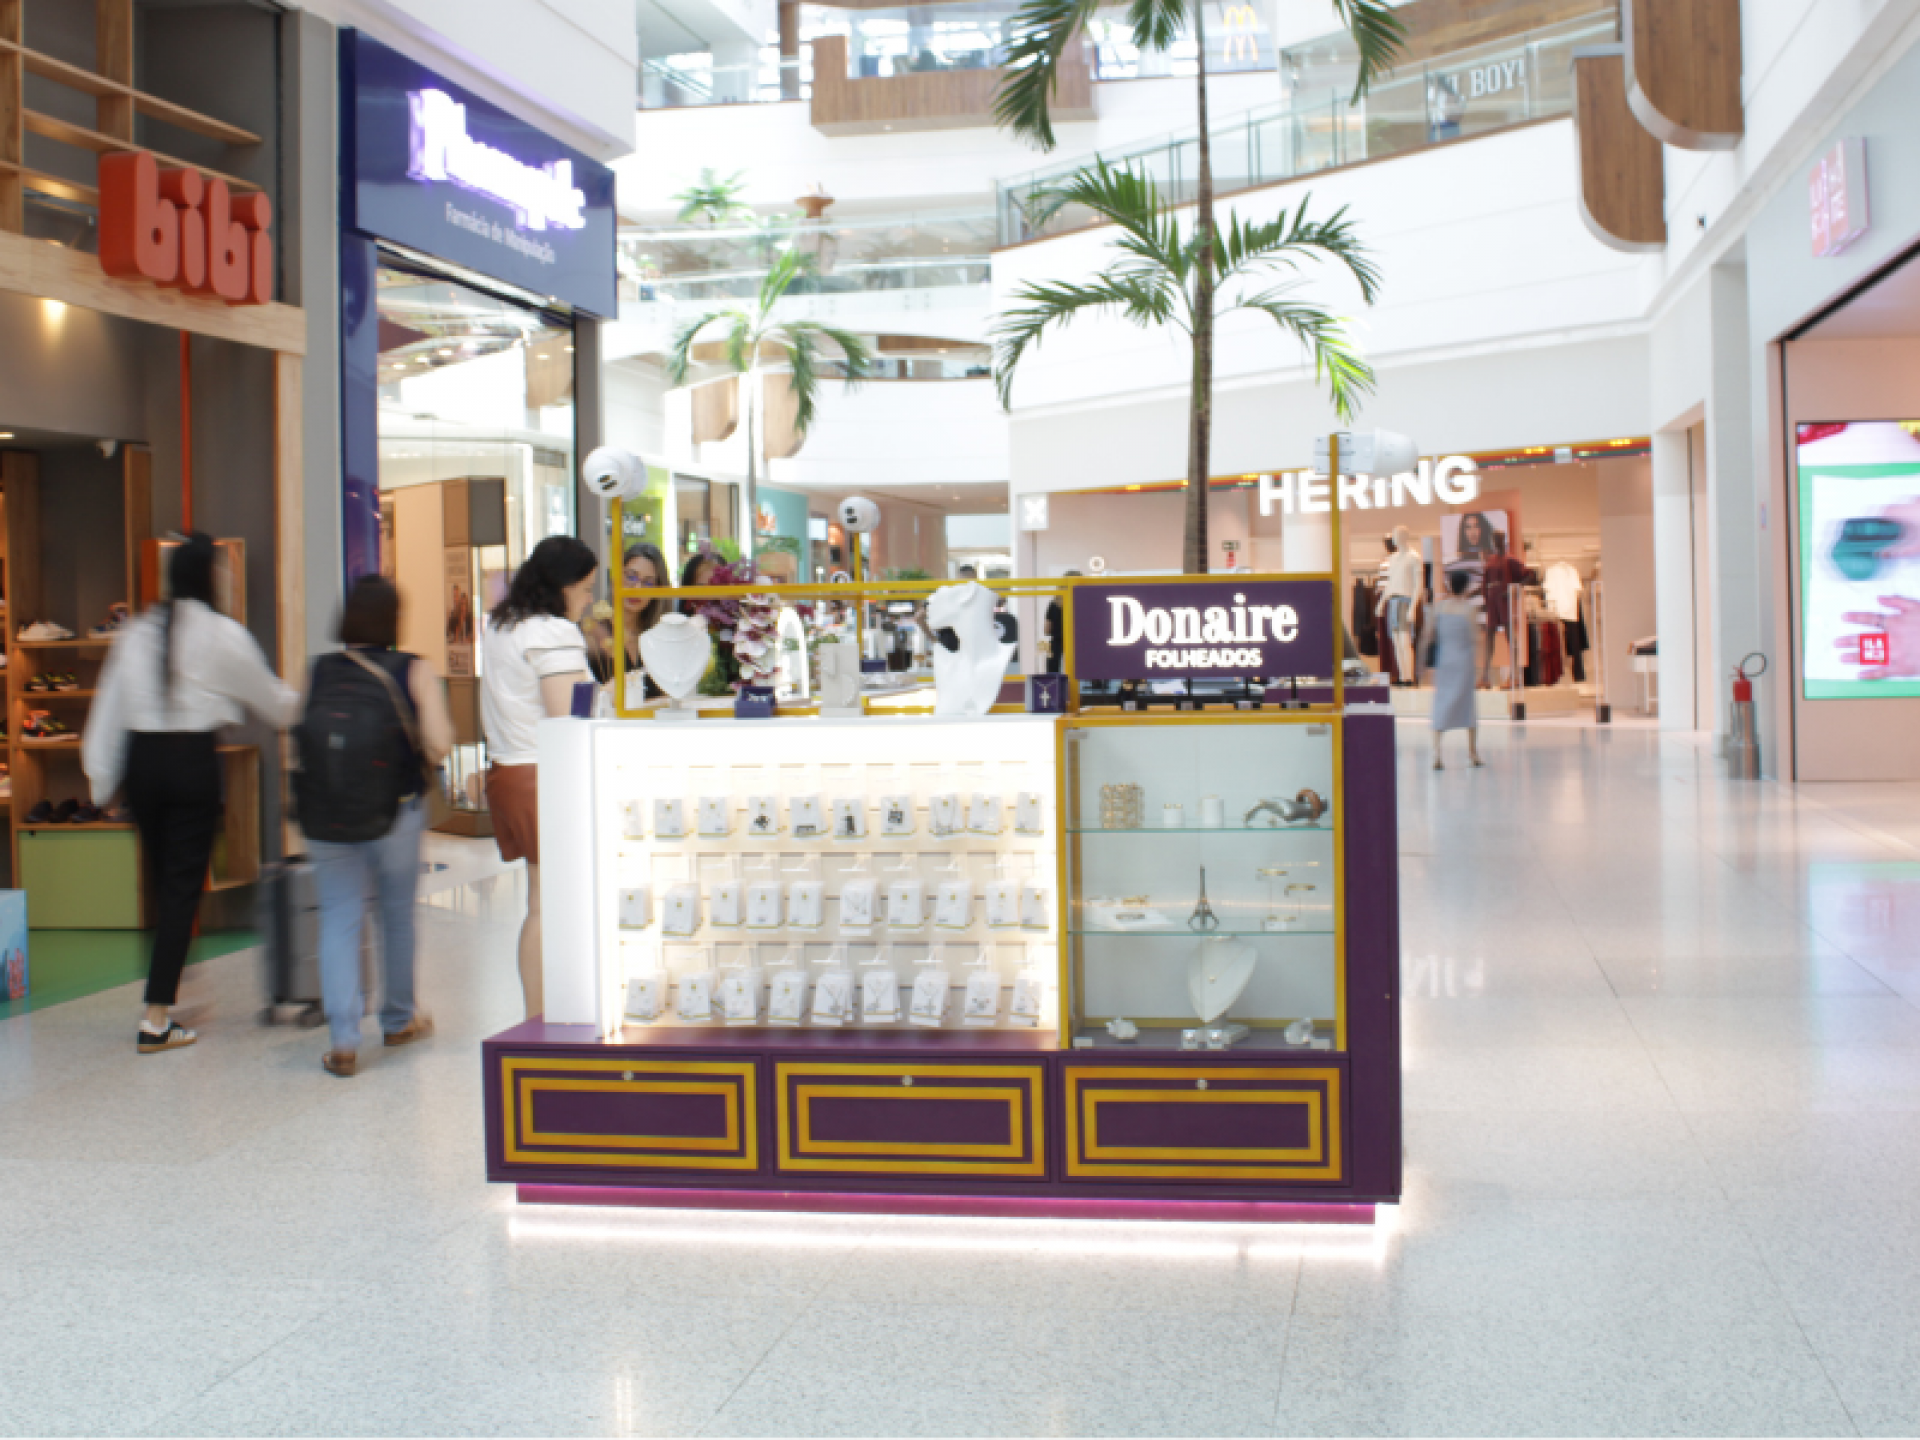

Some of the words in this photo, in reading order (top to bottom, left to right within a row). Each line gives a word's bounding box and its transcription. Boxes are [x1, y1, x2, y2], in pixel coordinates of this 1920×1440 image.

[1469, 57, 1525, 98] BOY!
[125, 149, 272, 306] bibi
[1259, 455, 1482, 517] HERING
[1105, 592, 1299, 647] Donaire
[1144, 647, 1263, 669] FOLHEADOS
